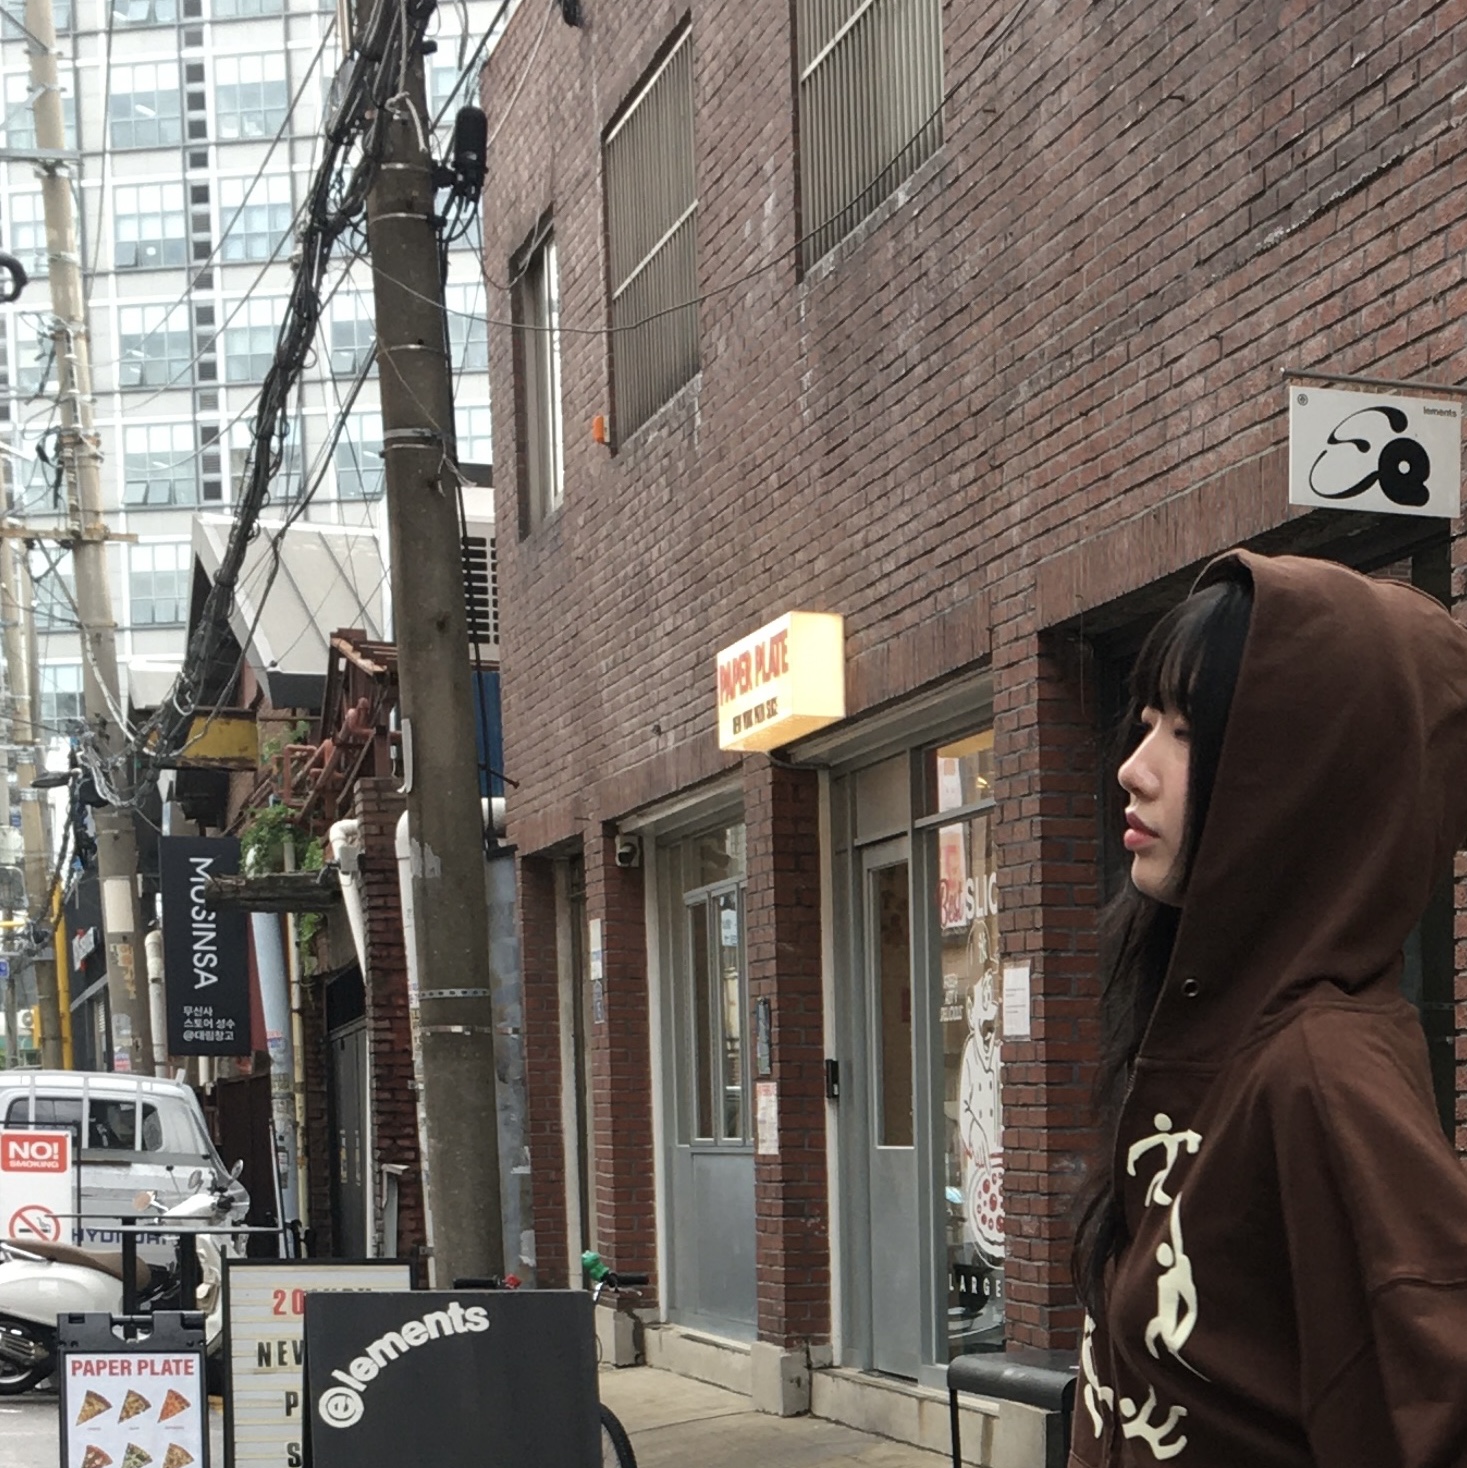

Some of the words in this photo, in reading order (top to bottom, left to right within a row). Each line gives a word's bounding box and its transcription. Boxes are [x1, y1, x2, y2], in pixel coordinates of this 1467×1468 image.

[719, 650, 752, 707] PAPER
[755, 628, 789, 687] PLATE
[183, 1005, 213, 1017] 무신사
[183, 1018, 214, 1029] 스토어
[215, 1018, 236, 1030] 성수
[8, 1141, 60, 1160] NO!
[9, 1160, 60, 1169] SMOKING
[948, 1273, 1002, 1298] LARGE
[71, 1359, 133, 1377] PAPER
[137, 1358, 195, 1377] PLATE
